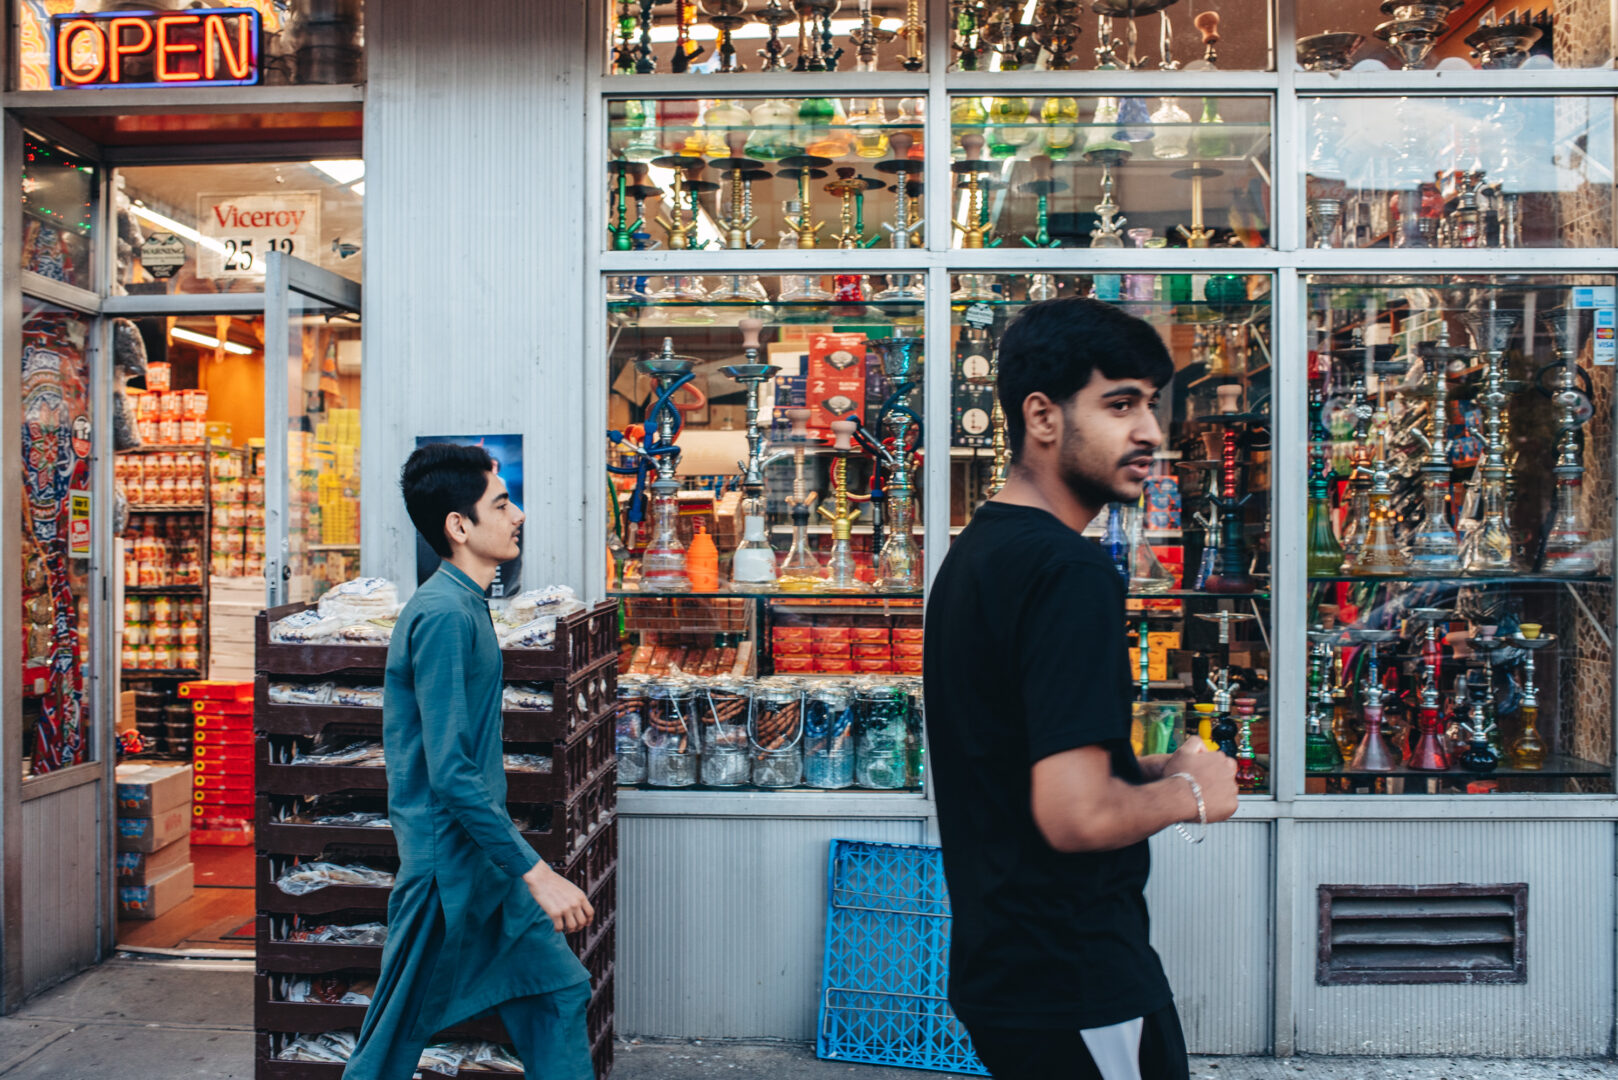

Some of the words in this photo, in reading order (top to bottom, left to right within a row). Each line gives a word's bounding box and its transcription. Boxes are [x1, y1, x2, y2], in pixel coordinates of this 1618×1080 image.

[58, 14, 249, 84] OPEN
[213, 204, 305, 235] Viceroy
[224, 239, 254, 270] 25
